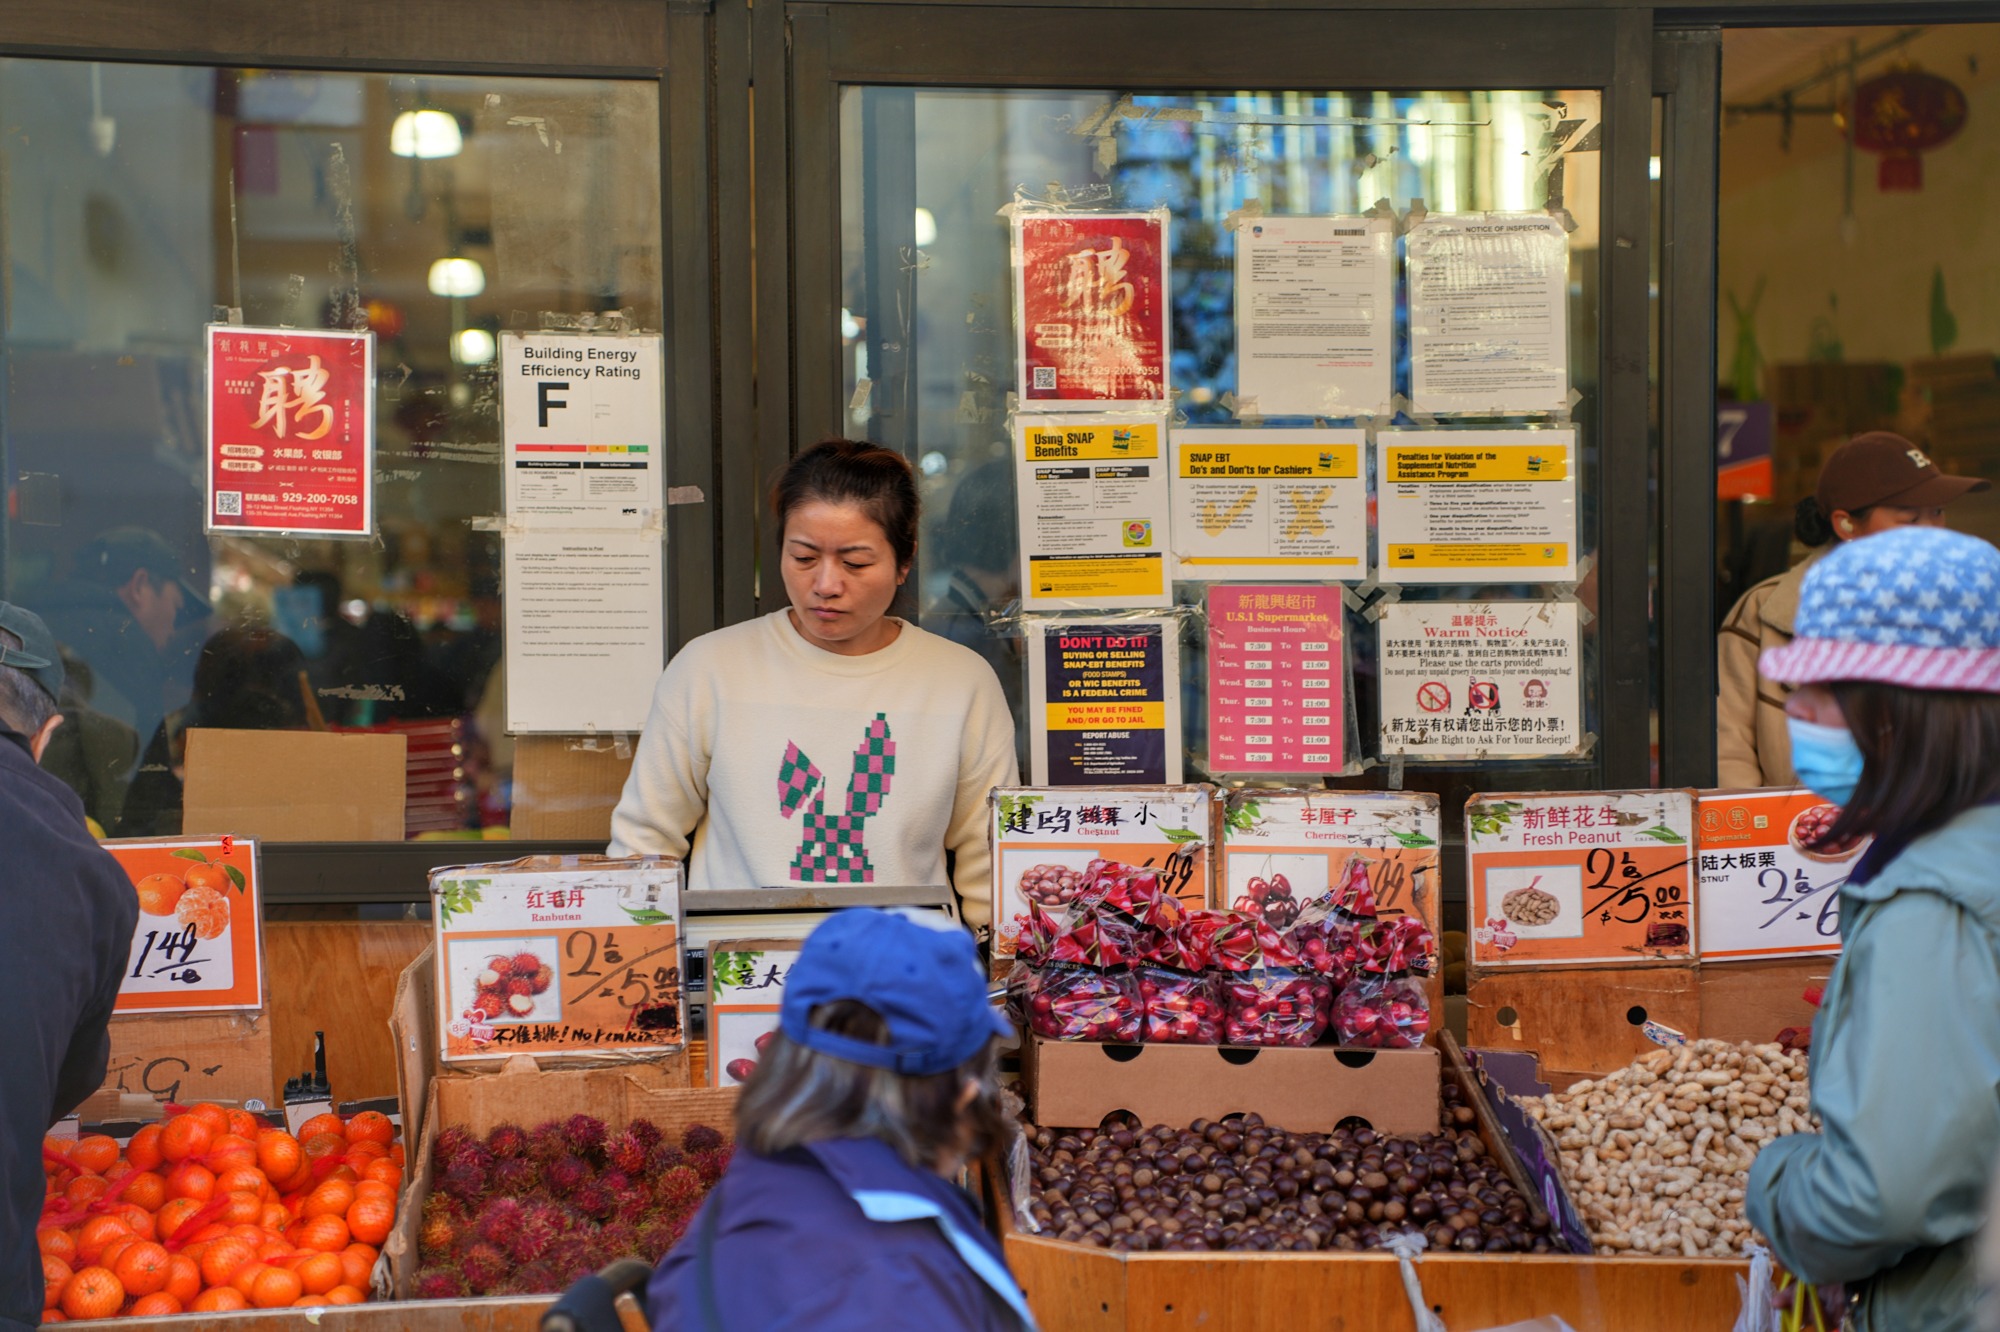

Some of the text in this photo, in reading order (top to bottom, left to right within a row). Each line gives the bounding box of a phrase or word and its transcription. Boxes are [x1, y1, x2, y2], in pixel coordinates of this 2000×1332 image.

[1506, 224, 1550, 232] INSPECTION
[524, 347, 637, 363] Building Energy
[521, 364, 641, 380] Efficiency Rating
[250, 354, 334, 440] 聘
[538, 382, 569, 427] F
[1034, 432, 1095, 446] Using SNAP
[1035, 445, 1078, 457] Benefits
[1190, 453, 1230, 462] SNAP EBT
[1190, 465, 1312, 474] Do's and Don'ts for Cashiers
[1397, 461, 1476, 470] Supplemental Nutrition
[1397, 470, 1469, 479] Assistance Program
[282, 492, 358, 505] 929-200-7058
[1239, 594, 1317, 610] 新龍興超市
[1226, 612, 1329, 624] U.S.1 Supermarket
[1451, 615, 1498, 627] 温馨提示
[1424, 627, 1528, 638] Warm Notice
[1060, 636, 1148, 649] DON'T DO IT!
[1062, 651, 1145, 659] BUYING OR SELLING
[1063, 660, 1145, 669] SNAP-EBT BENEFITS
[1420, 658, 1543, 669] Please use the carts provided!
[1101, 670, 1127, 678] STAMPS)
[1069, 679, 1140, 688] OR WIC BENEFITS
[1073, 689, 1079, 697] A
[1081, 689, 1118, 697] FEDERAL
[1067, 706, 1084, 714] YOU
[1086, 706, 1104, 714] MAY
[1066, 716, 1100, 725] AND/OR
[1108, 731, 1130, 739] ABUSE
[1386, 735, 1400, 744] We
[1402, 735, 1424, 744] Hae
[1441, 735, 1463, 746] Right
[1466, 736, 1475, 744] to
[1477, 735, 1493, 744] Ask
[1496, 735, 1510, 744] For
[1513, 735, 1533, 744] Your
[1536, 735, 1570, 746] Reciept!
[1300, 807, 1356, 825] 车厘子
[1523, 804, 1618, 830] 新鲜花生
[1077, 827, 1120, 836] Chestnut
[1304, 831, 1347, 840] Cherries
[1523, 830, 1622, 846] Fresh Peanut
[1701, 851, 1776, 872] 陆大板栗
[526, 889, 585, 909] 红毛丹
[531, 913, 582, 922] Ranbutan
